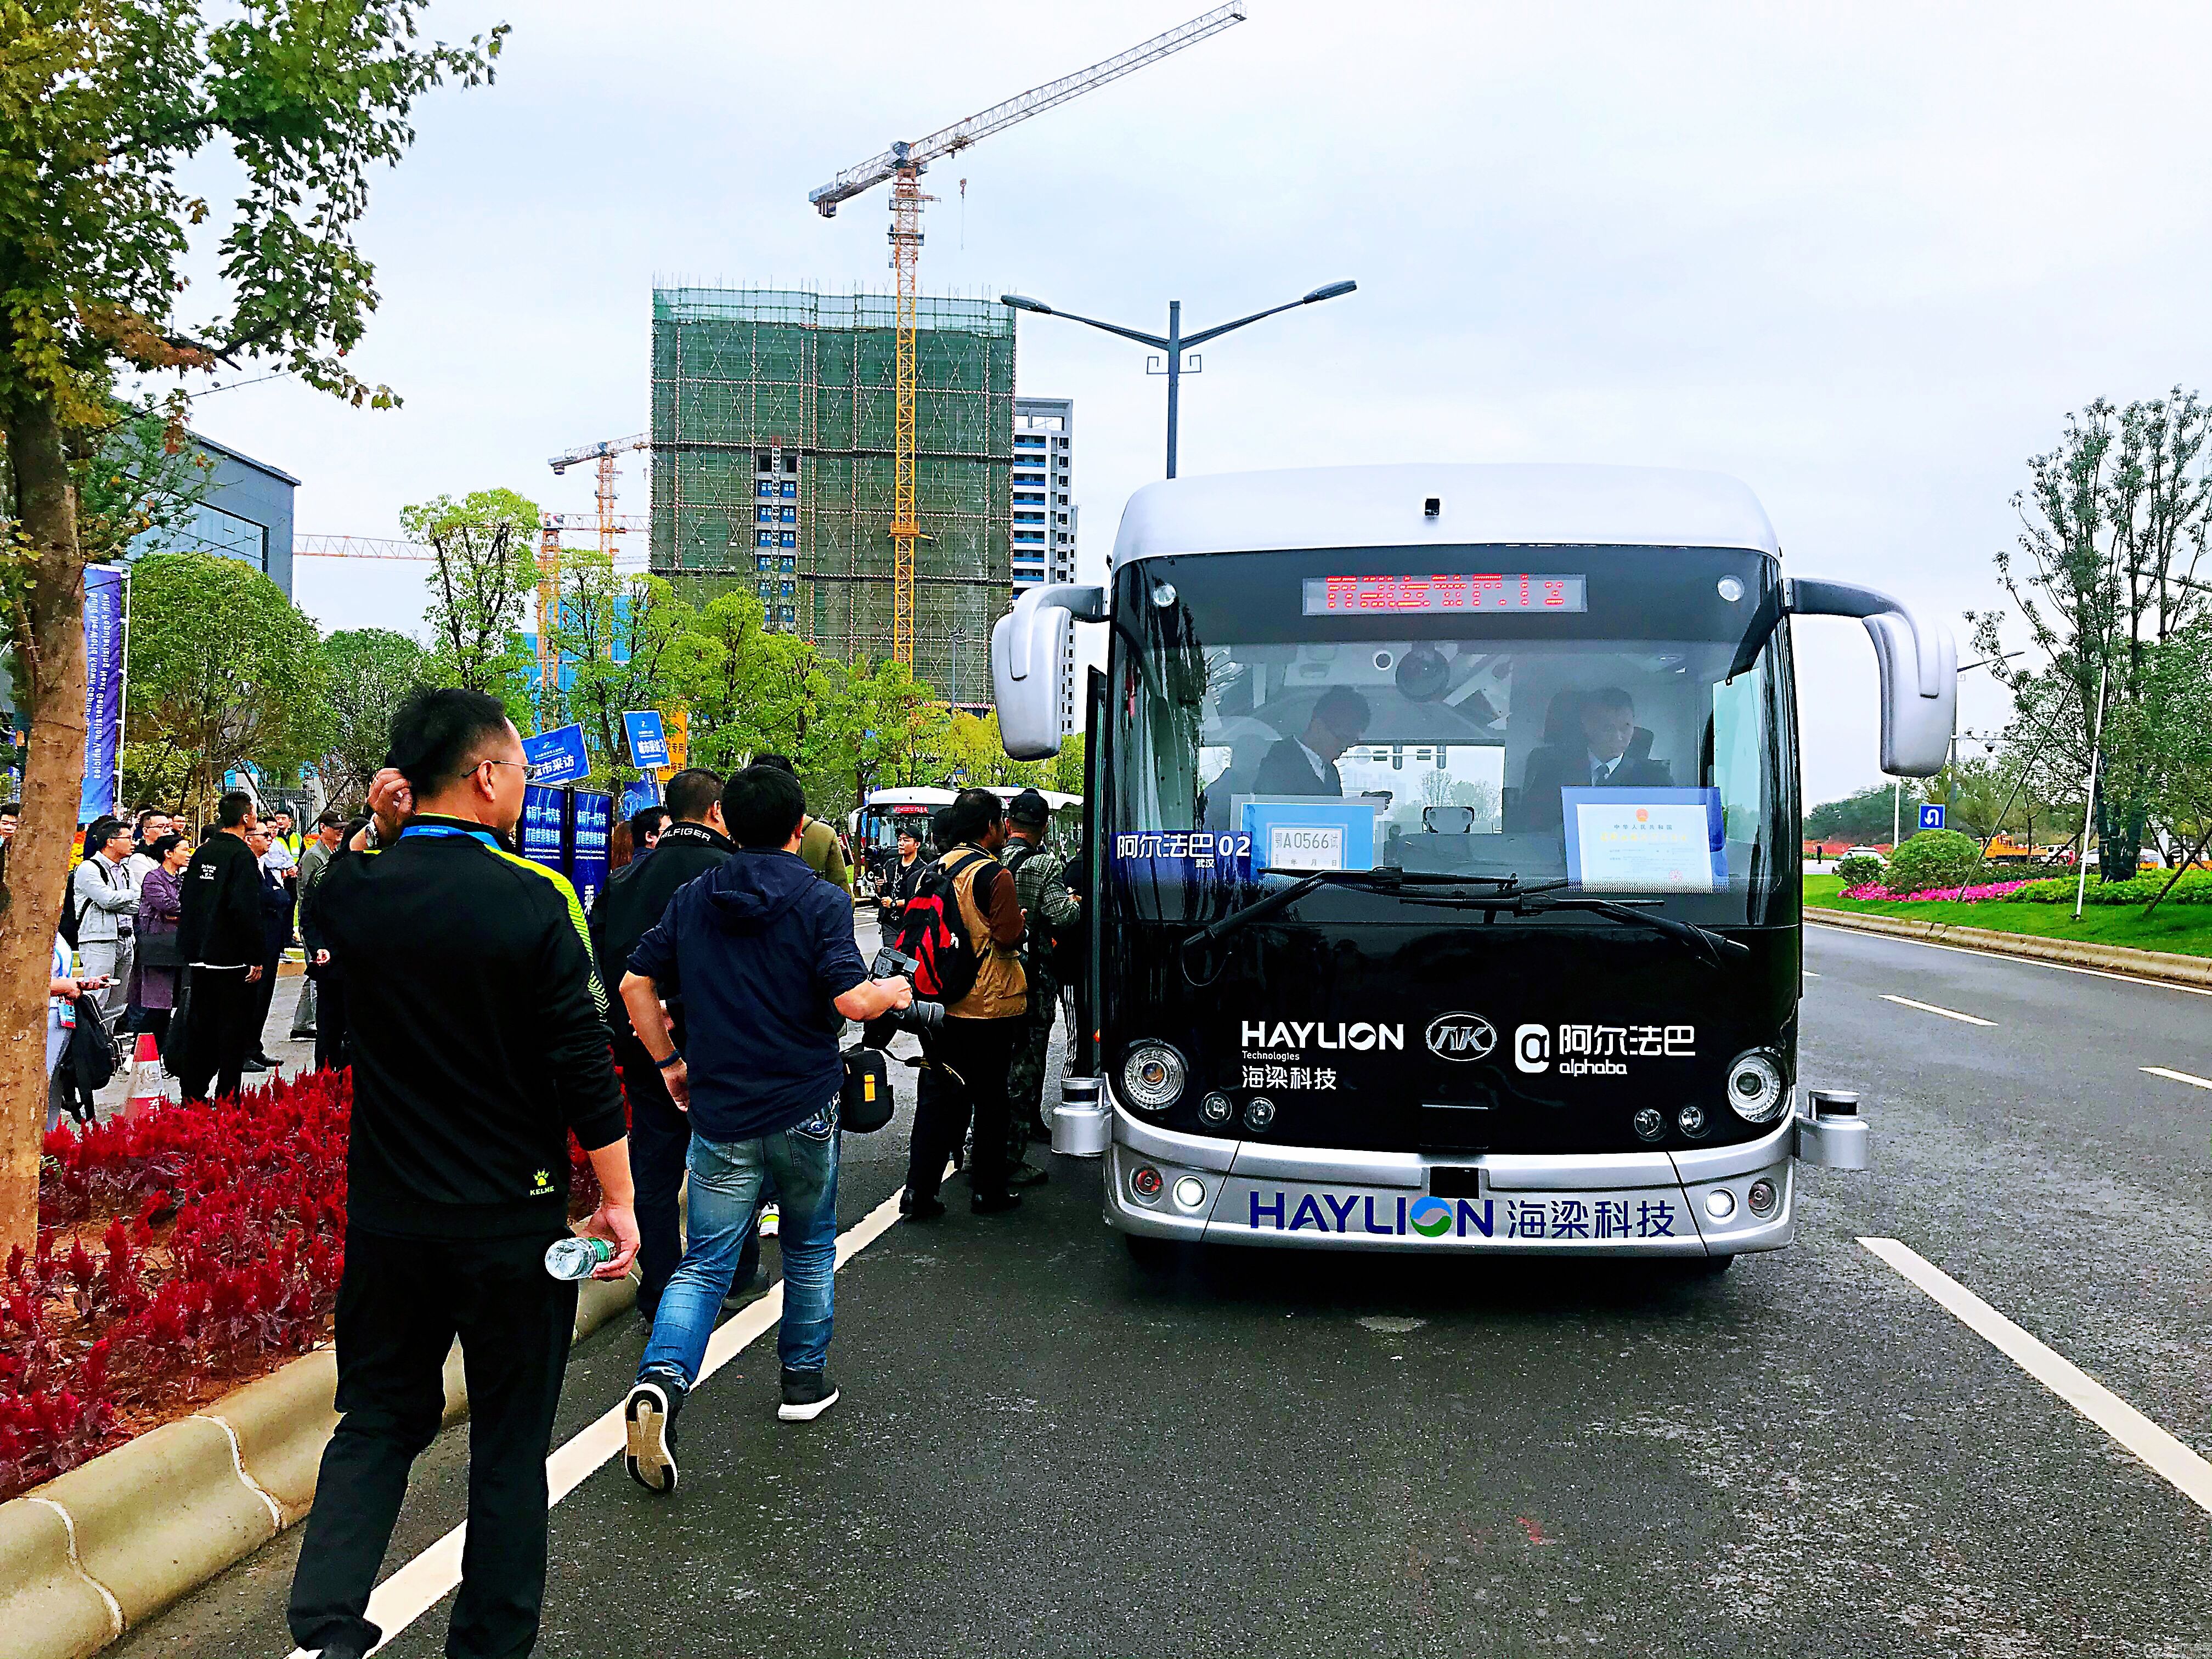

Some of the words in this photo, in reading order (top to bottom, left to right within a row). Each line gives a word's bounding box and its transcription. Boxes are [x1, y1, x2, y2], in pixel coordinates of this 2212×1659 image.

[1117, 833, 1214, 859] 阿尔法巴
[1218, 836, 1250, 857] 02
[1195, 858, 1215, 868] 武汉
[1242, 1020, 1404, 1051] HAYLION
[1559, 1024, 1696, 1056] 阿尔法巴
[1242, 1050, 1300, 1062] Technologies
[1559, 1058, 1628, 1077] alphaba
[1242, 1064, 1336, 1090] 海梁科技
[529, 1186, 555, 1196] KELME
[1249, 1190, 1494, 1238] HAYLION
[1506, 1199, 1676, 1239] 海梁科技
